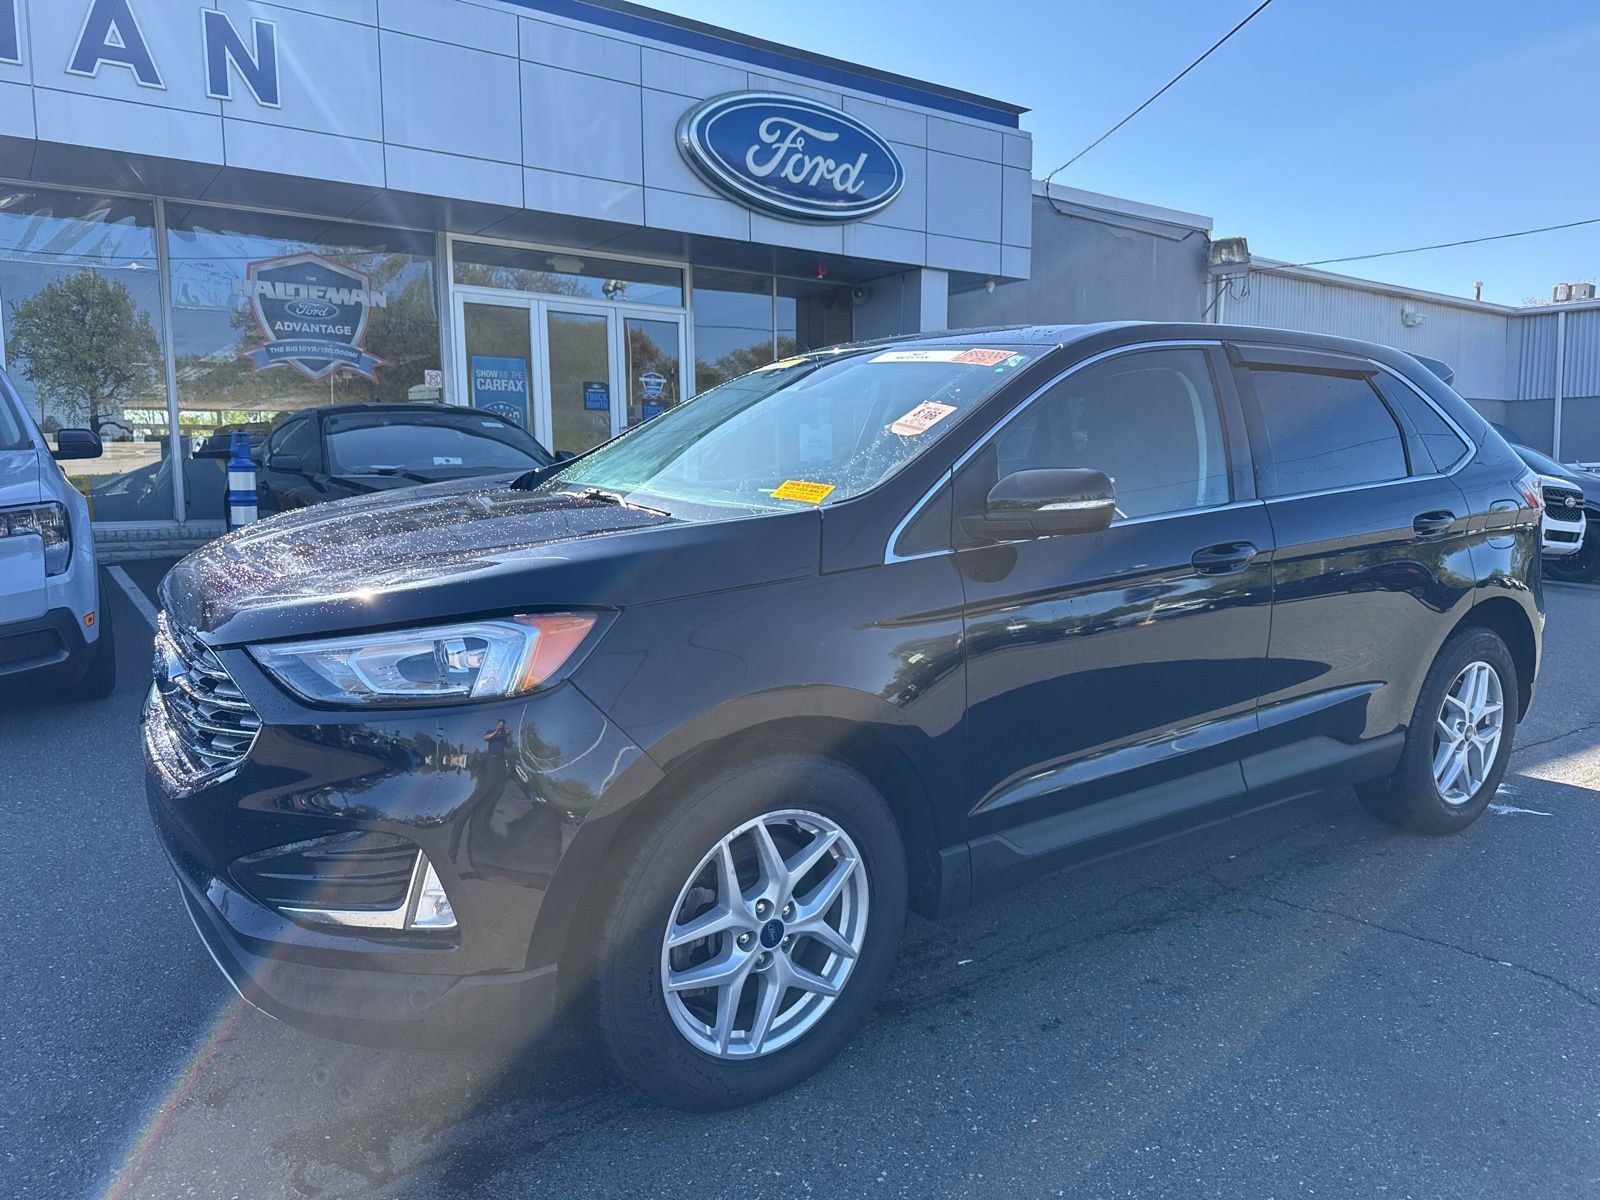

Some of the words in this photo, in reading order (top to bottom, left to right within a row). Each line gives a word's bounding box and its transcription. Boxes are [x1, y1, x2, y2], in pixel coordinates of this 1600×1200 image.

[0, 0, 281, 109] AN
[745, 116, 869, 195] Ford
[295, 302, 329, 318] Ford
[274, 321, 352, 335] ADVANTAGE
[475, 369, 498, 378] SHOW
[476, 378, 525, 392] CARFAX
